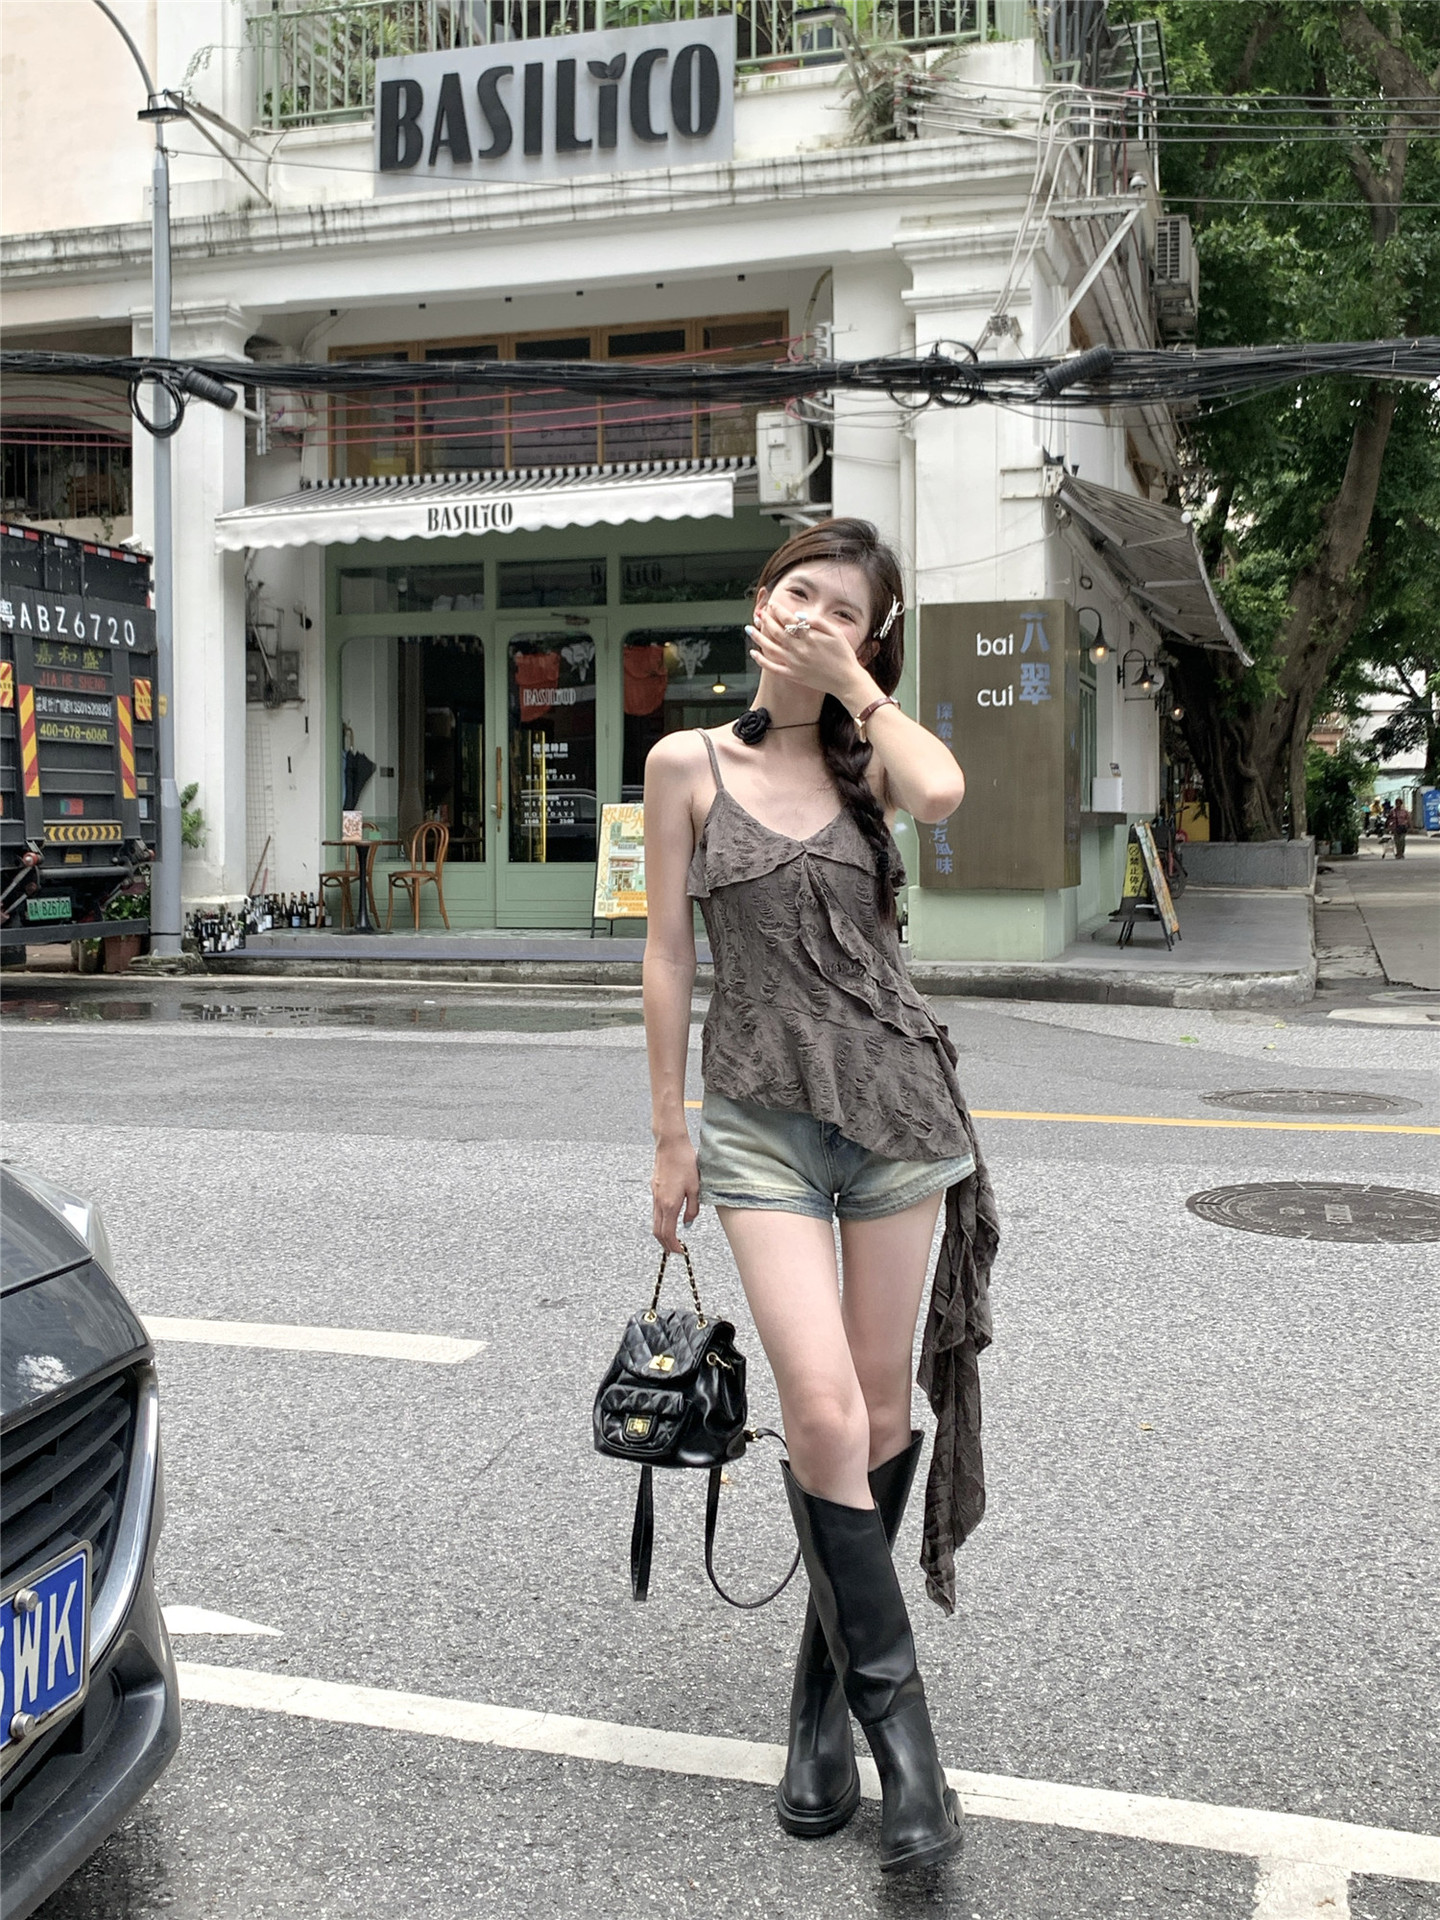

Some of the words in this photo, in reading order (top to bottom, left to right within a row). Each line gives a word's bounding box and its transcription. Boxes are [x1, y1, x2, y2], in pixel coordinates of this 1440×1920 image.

[976, 632, 1014, 656] bai
[39, 671, 58, 686] JIA
[977, 684, 1014, 707] cui
